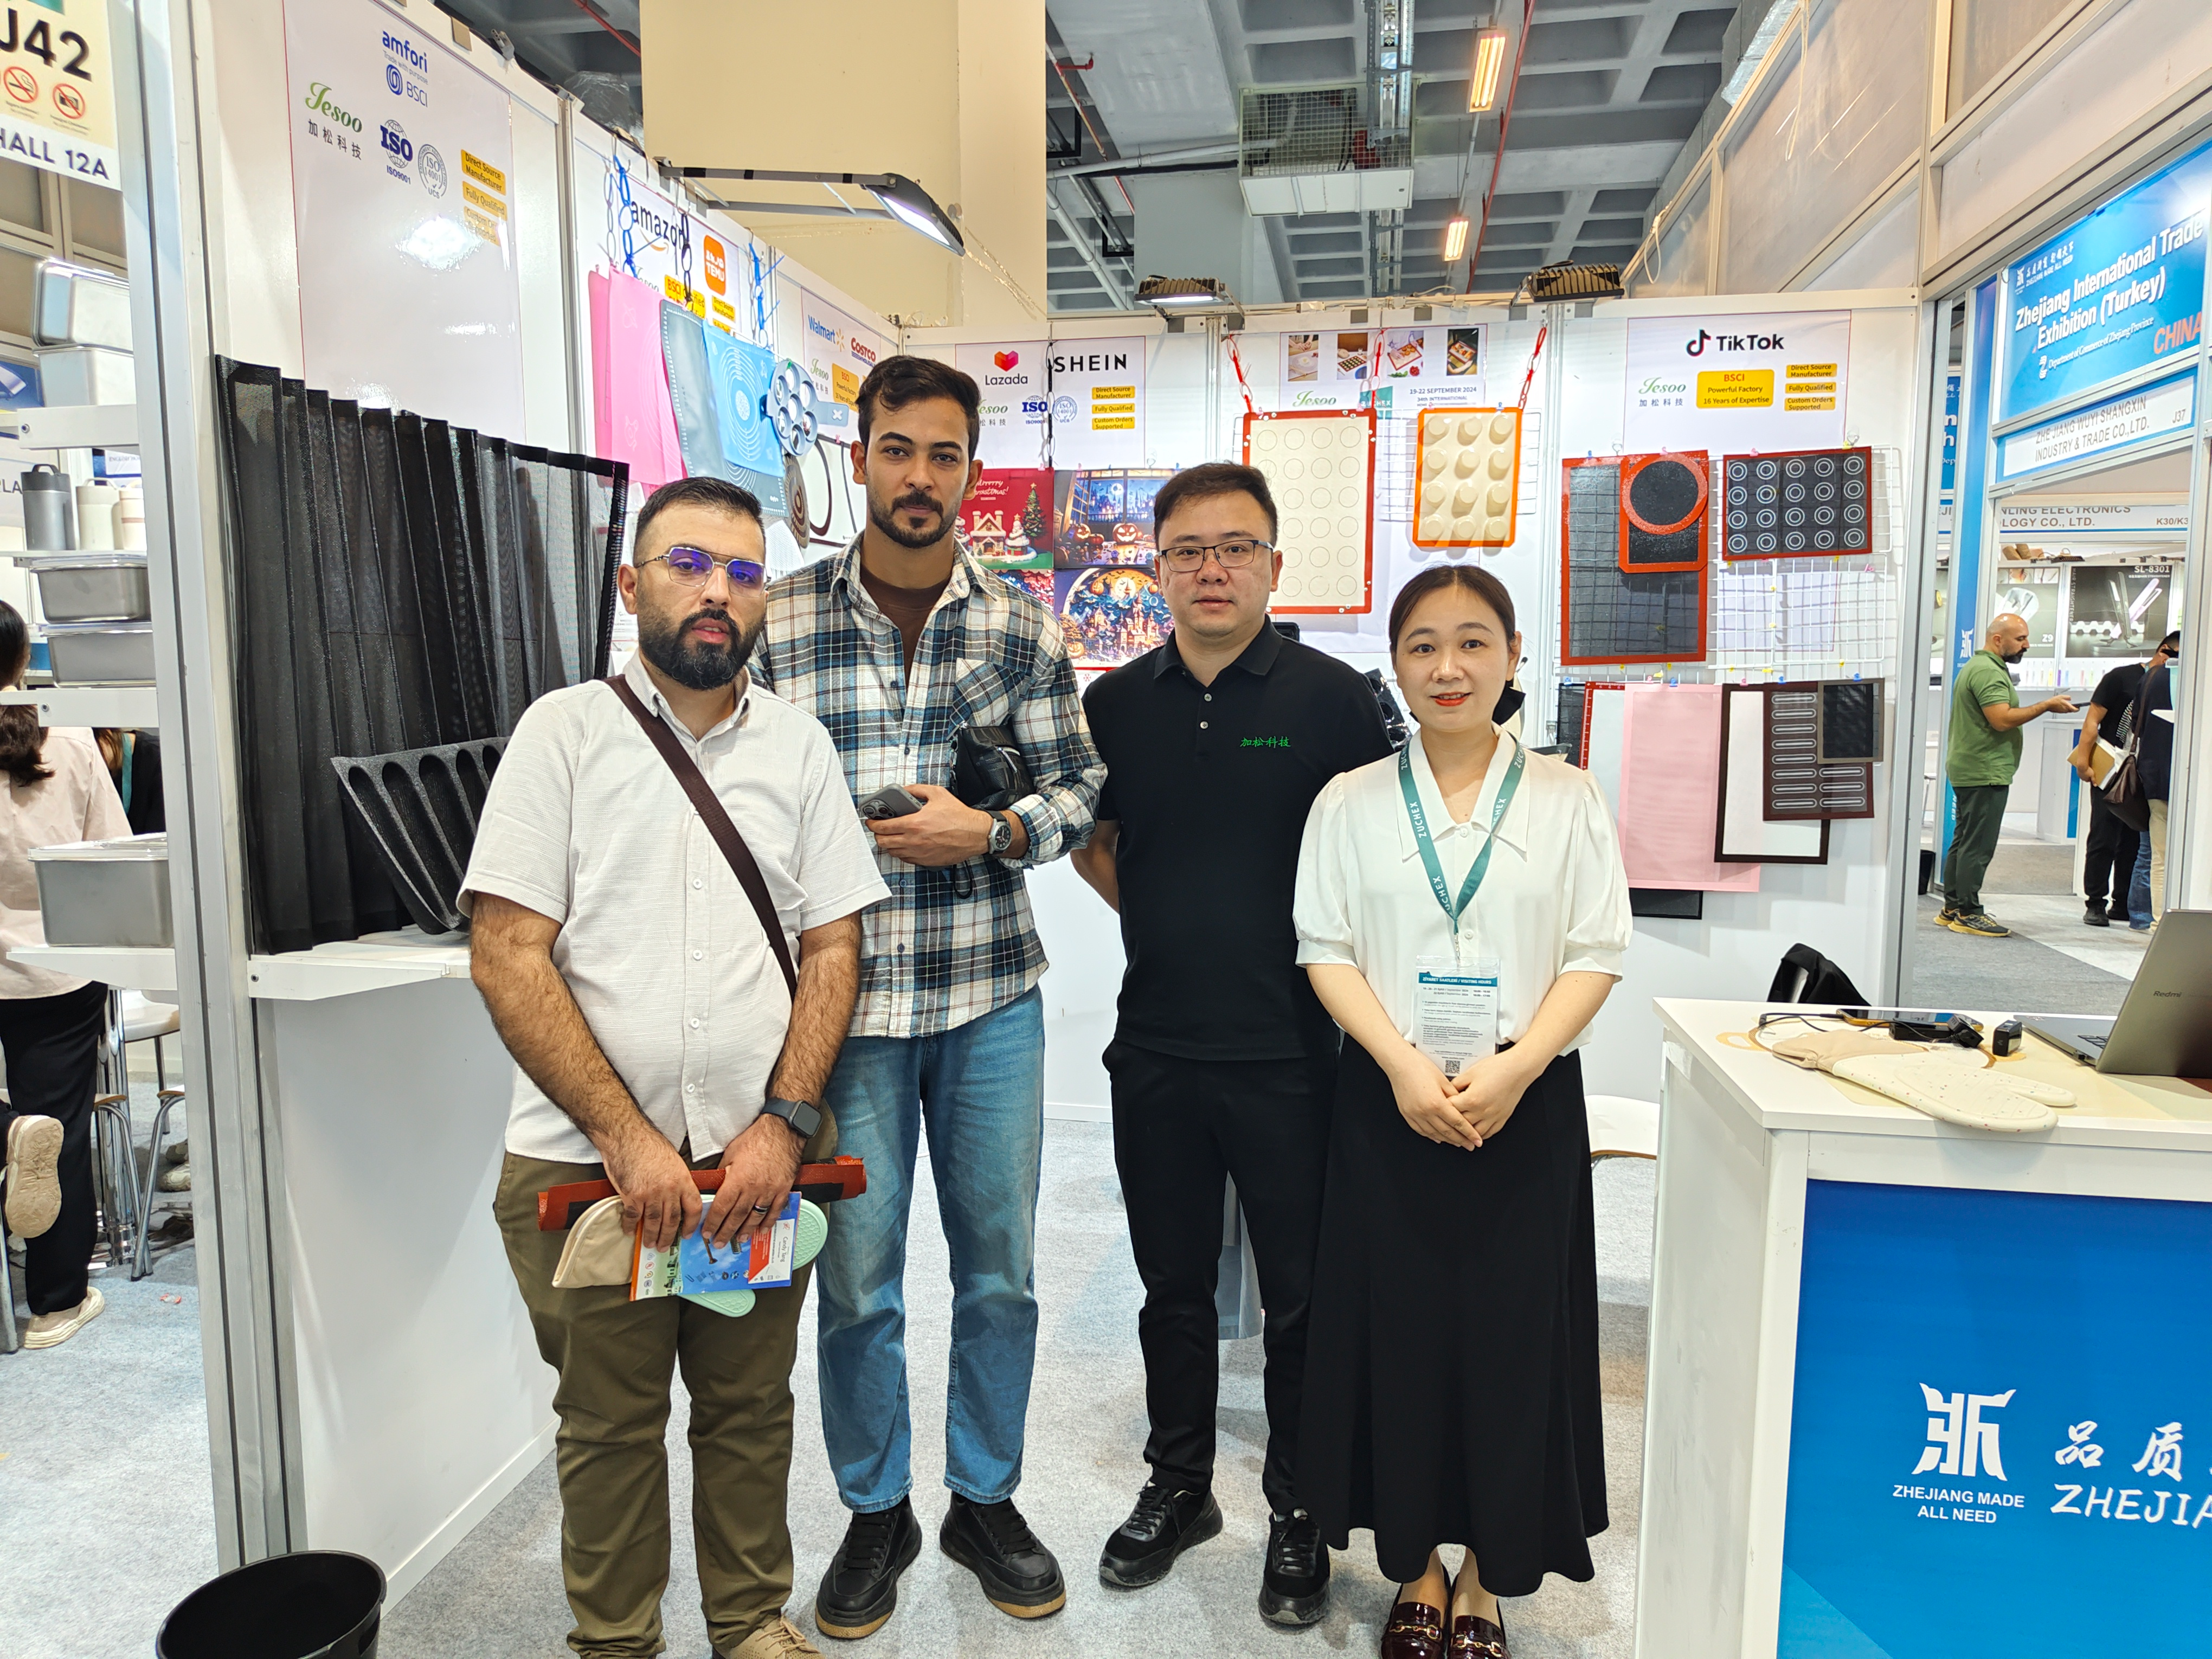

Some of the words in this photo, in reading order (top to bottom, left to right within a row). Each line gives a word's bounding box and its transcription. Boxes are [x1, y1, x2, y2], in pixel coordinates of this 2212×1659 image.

[0, 8, 92, 82] J42
[382, 30, 427, 73] amfori
[383, 50, 397, 65] Trade
[409, 67, 428, 85] purpose
[407, 81, 428, 107] BSCI
[305, 82, 363, 134] Jesoo
[308, 119, 362, 160] 加松科技
[380, 125, 413, 162] ISO
[65, 150, 110, 181] 12A
[426, 156, 440, 172] ISO
[465, 153, 482, 169] Direct
[483, 163, 501, 180] Source
[387, 165, 411, 184] ISO9001
[425, 167, 441, 183] 14001
[466, 164, 502, 191] Manufacturer
[428, 187, 440, 199] UCS
[466, 188, 479, 203] Fully
[480, 196, 505, 215] Qualified
[706, 262, 725, 282] TEMU
[2015, 288, 2070, 332] Zhejiang
[2073, 236, 2156, 303] International
[2159, 217, 2203, 256] Trade
[667, 279, 681, 295] BSCI
[2037, 305, 2097, 350] Exhibition
[2100, 266, 2166, 325] (Turkey)
[808, 314, 836, 344] Walmart
[2153, 312, 2202, 354] CHINA
[851, 337, 876, 362] COSTCO
[1716, 333, 1785, 351] TikTok
[810, 358, 829, 381] Jesoo
[1053, 353, 1127, 373] SHEIN
[985, 373, 1028, 385] Lazada
[1638, 377, 1686, 395] Jesoo
[1724, 374, 1745, 382] BSCI
[1804, 383, 1833, 391] Qualified
[1293, 390, 1336, 407] Jesoo
[1708, 385, 1737, 394] Powerful
[1738, 385, 1763, 394] Factory
[1022, 401, 1048, 413] ISO
[1639, 398, 1683, 407] 加松科技
[1739, 396, 1770, 405] Expertise
[979, 419, 1006, 427] 松科技
[2036, 429, 2050, 444] ZHE
[2052, 420, 2075, 439] JIANG
[2077, 412, 2099, 430] WUYI
[2100, 396, 2147, 423] SHANGXIN
[2172, 409, 2187, 423] J37
[2035, 439, 2073, 462] INDUSTRY
[2074, 436, 2080, 450] &
[2082, 427, 2110, 447] TRADE
[2000, 518, 2036, 528] LOGY
[2040, 517, 2065, 528] CO.,
[2069, 517, 2095, 526] LTD.
[2134, 565, 2170, 573] SL-8301
[2042, 634, 2054, 642] Z9
[1240, 736, 1291, 748] 加松科技
[1410, 801, 1427, 839] ZUCHEX
[1432, 875, 1450, 911] UCHEX
[2055, 1420, 2212, 1482] 品质
[1893, 1484, 1973, 1504] ZHEJIANG
[1977, 1492, 2025, 1508] MADE
[1917, 1505, 1949, 1520] ALL
[1953, 1508, 1997, 1523] NEED
